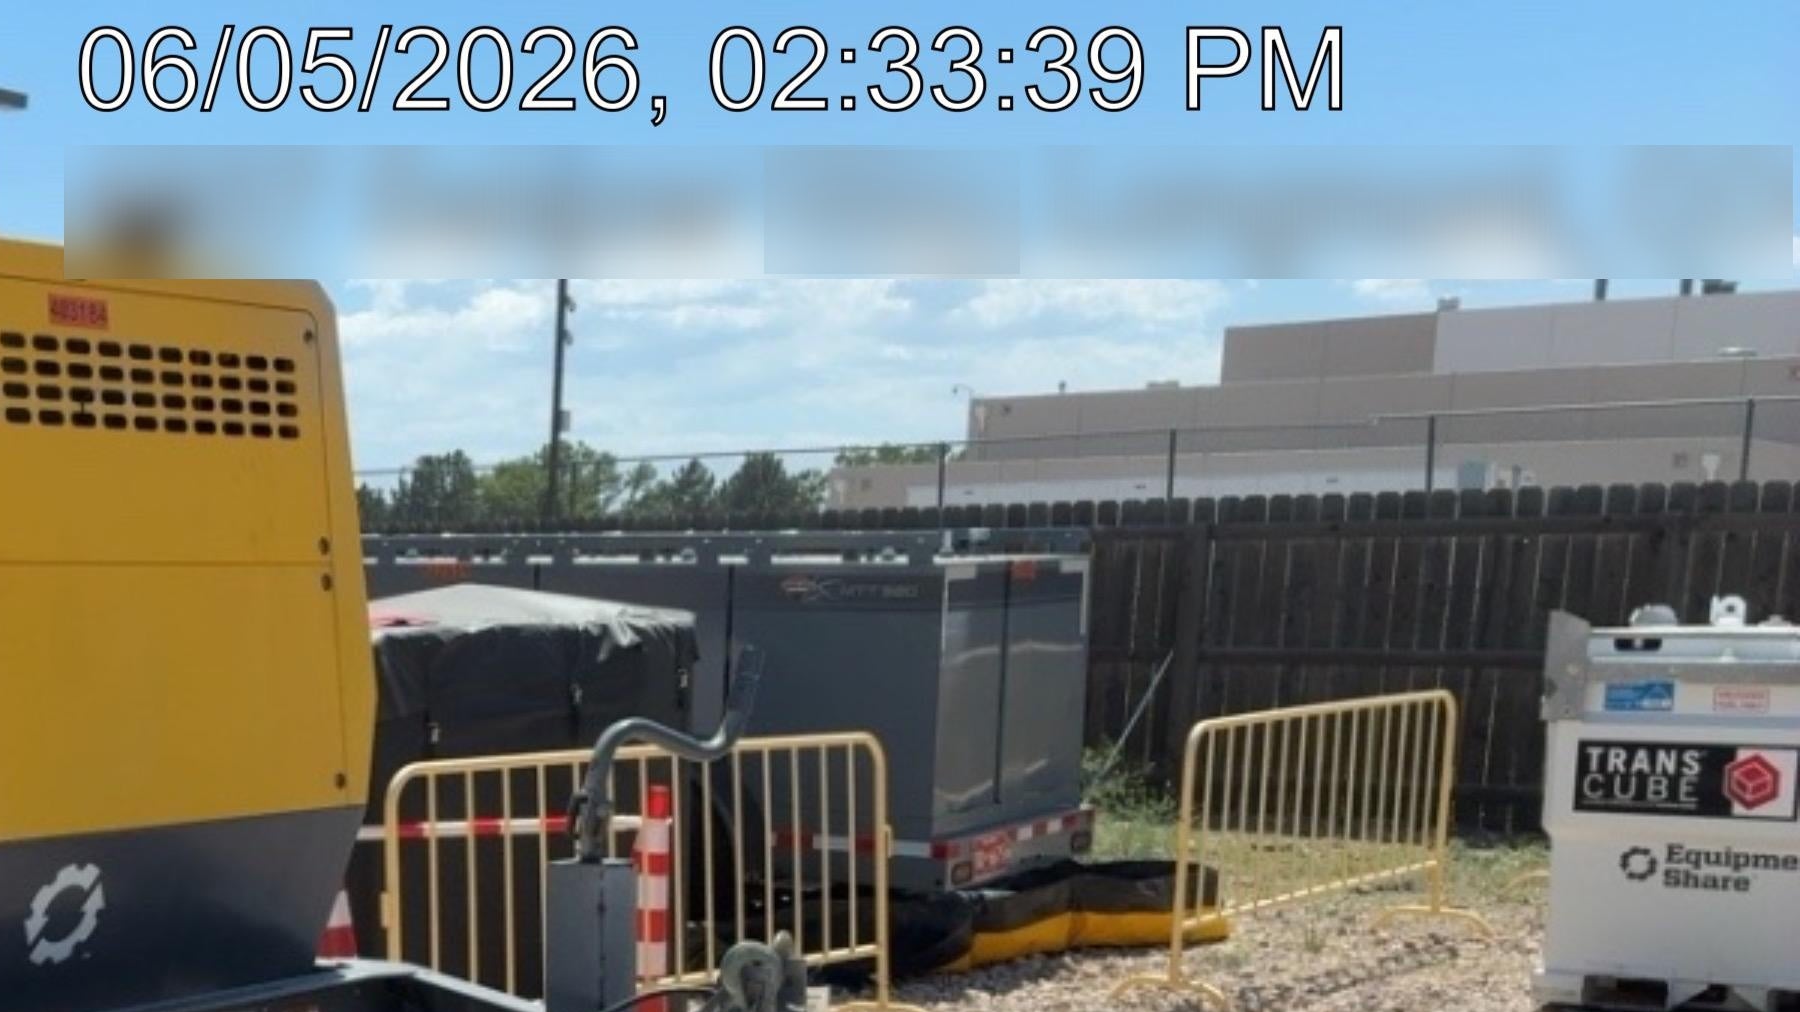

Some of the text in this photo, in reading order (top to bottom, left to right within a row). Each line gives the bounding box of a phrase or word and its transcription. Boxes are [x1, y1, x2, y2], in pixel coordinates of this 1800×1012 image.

[1584, 746, 1701, 775] TRANS
[1582, 773, 1699, 802] CUBE
[1665, 843, 1800, 872] Equipme
[1663, 867, 1751, 892] Share
